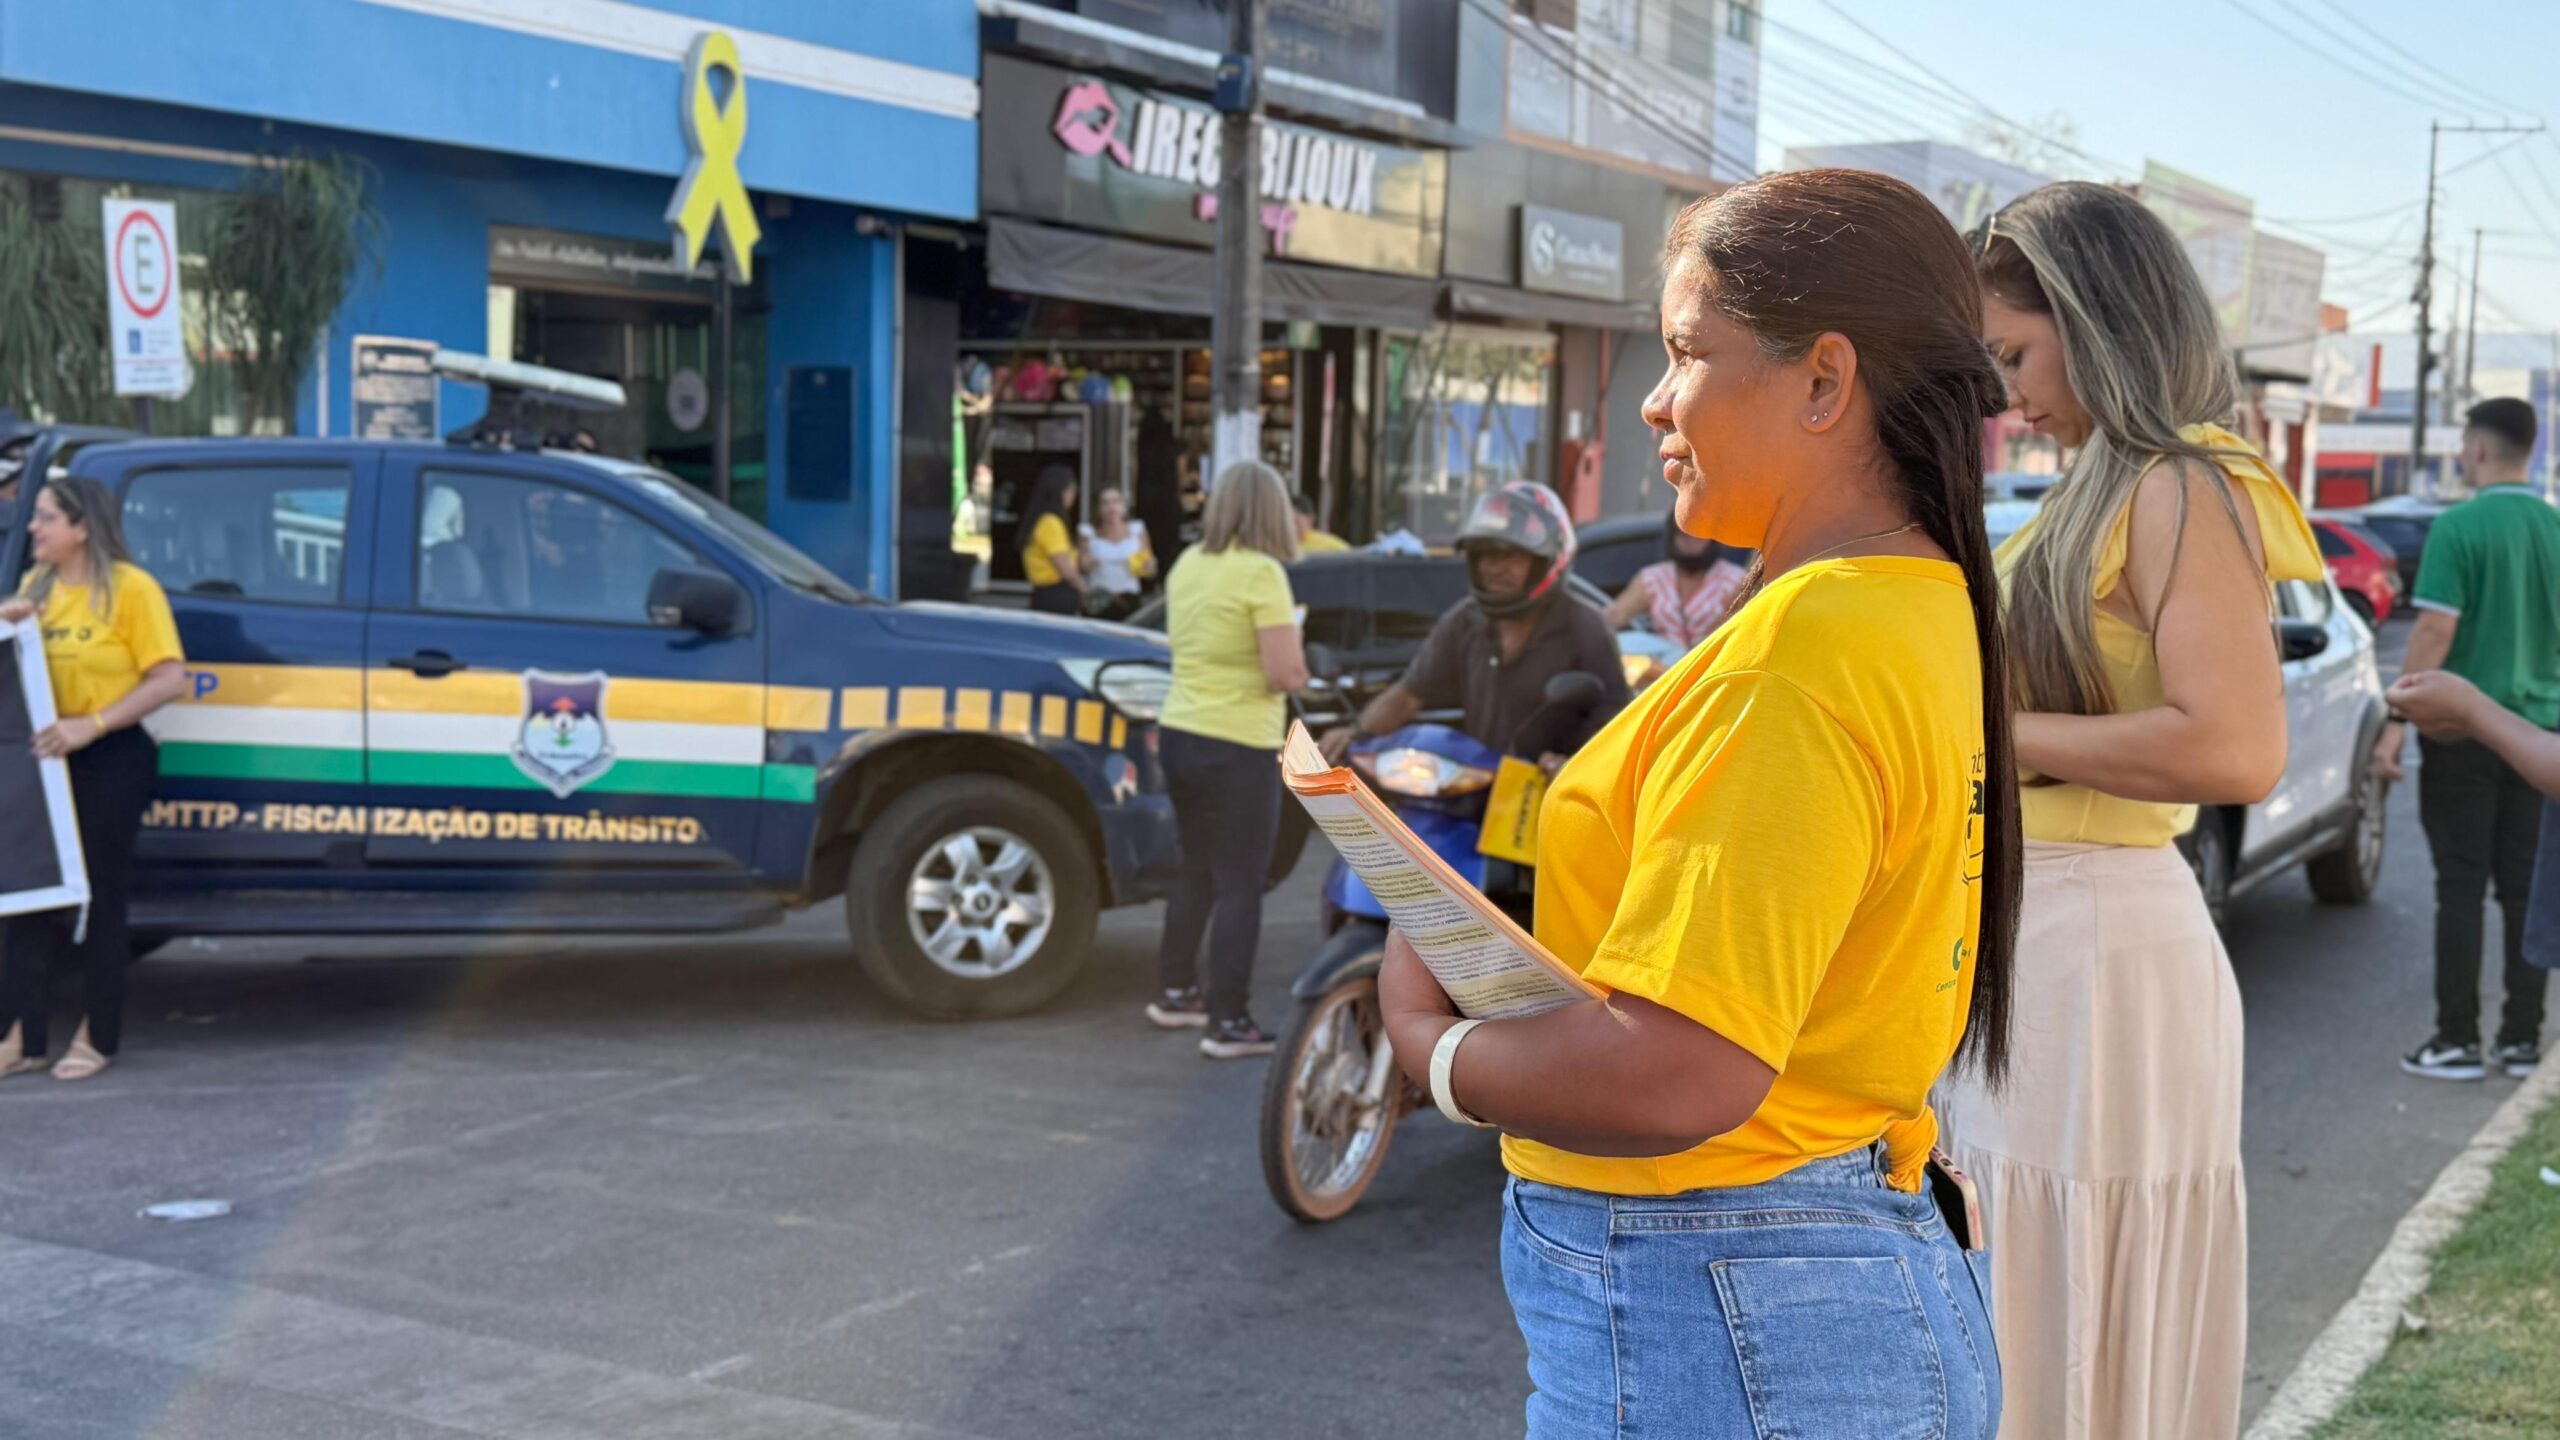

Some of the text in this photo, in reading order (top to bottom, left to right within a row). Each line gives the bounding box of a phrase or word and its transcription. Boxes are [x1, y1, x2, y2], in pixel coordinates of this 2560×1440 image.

[1133, 99, 1224, 188] IREC
[134, 233, 155, 294] E
[495, 811, 541, 840] DE
[544, 809, 701, 844] TRÂNSITO
